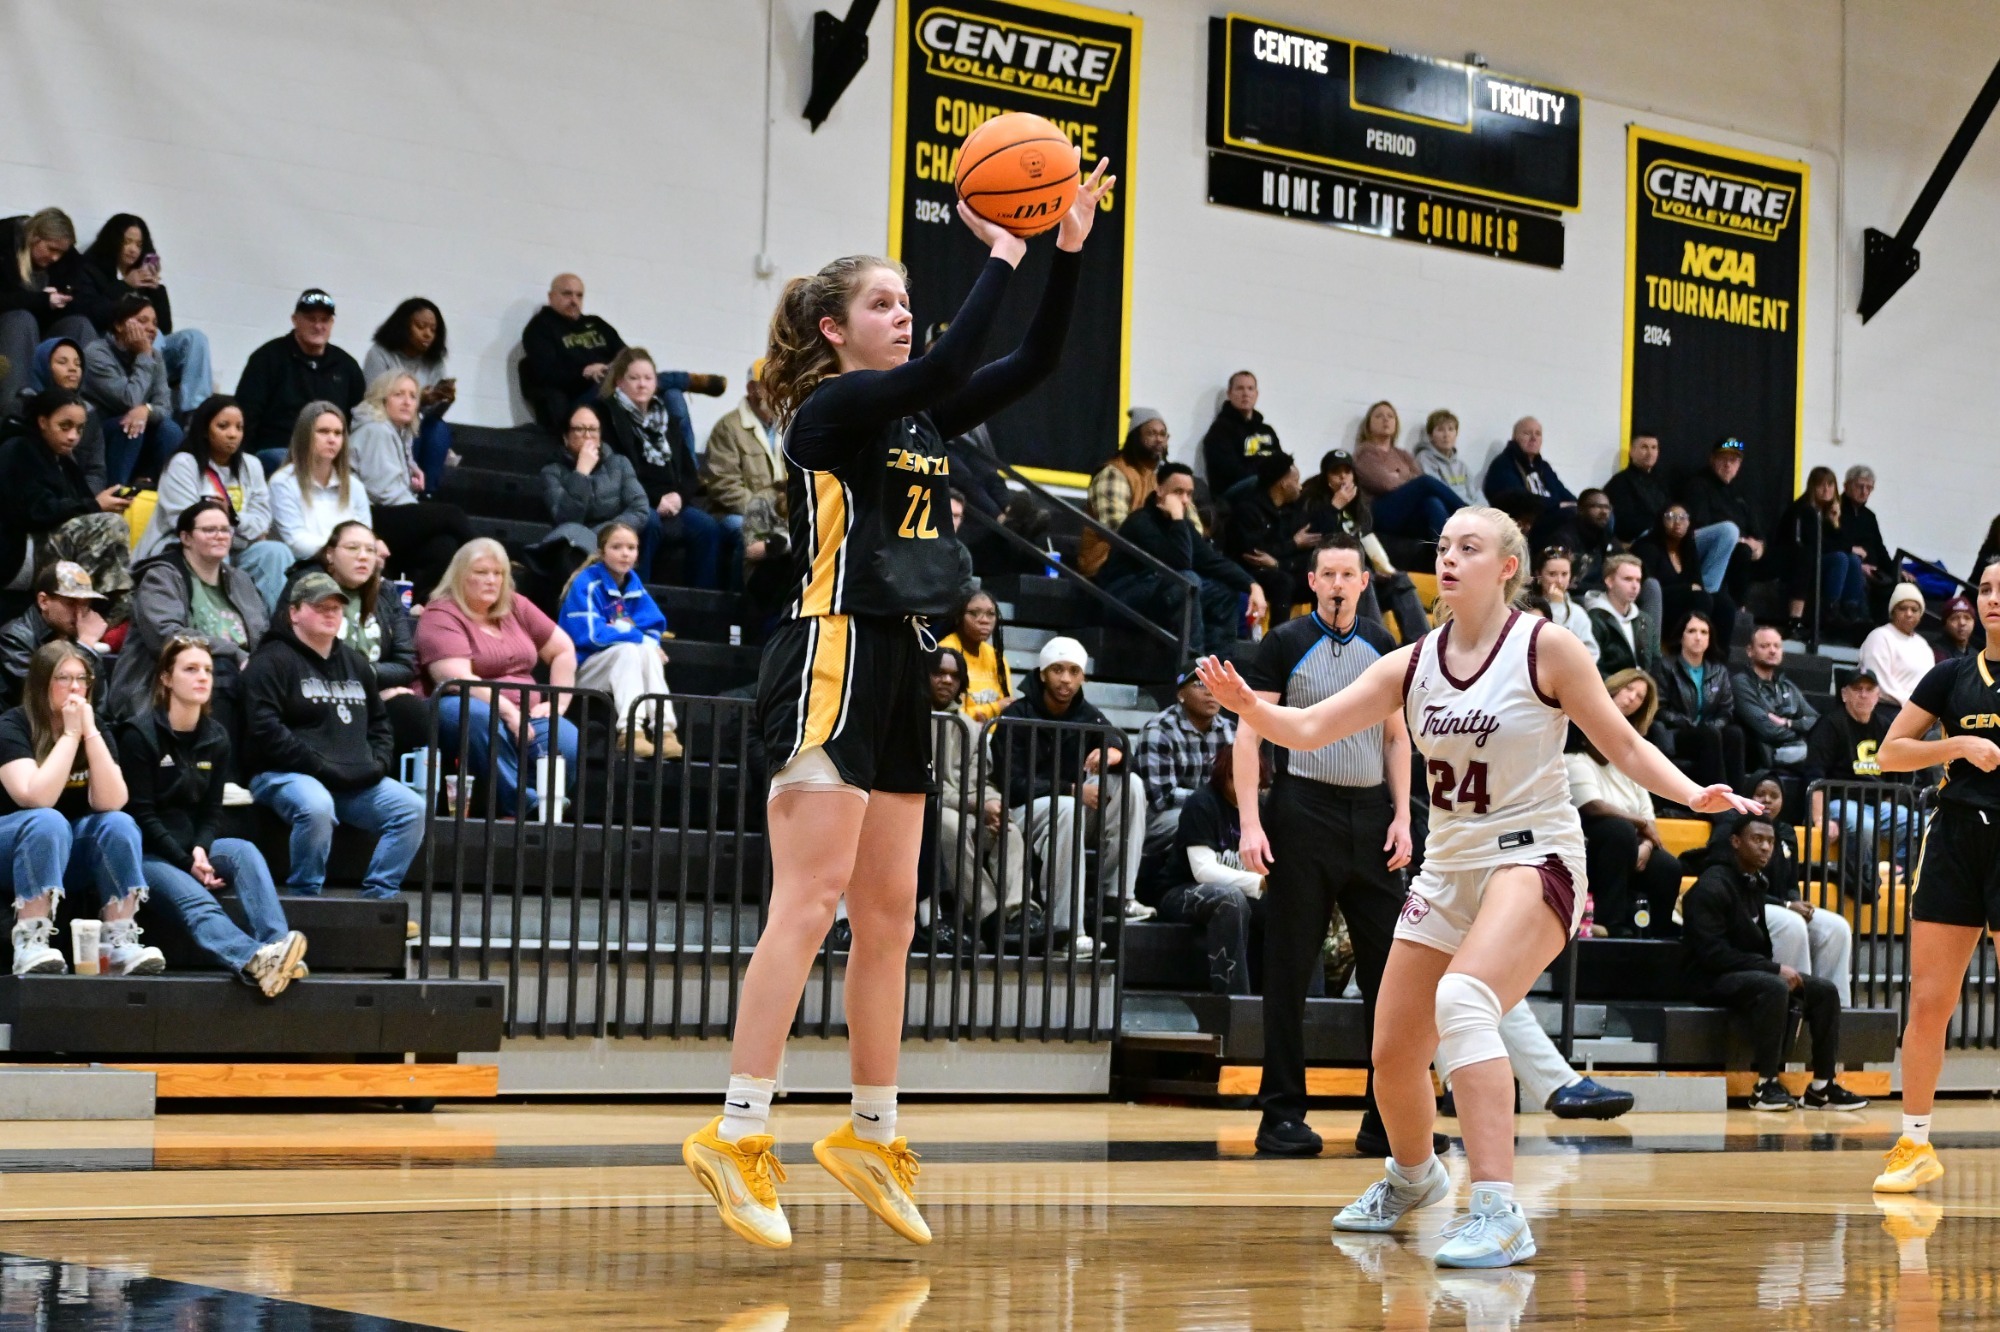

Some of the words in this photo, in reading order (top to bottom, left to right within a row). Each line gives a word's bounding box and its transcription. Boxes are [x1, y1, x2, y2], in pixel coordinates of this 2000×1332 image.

[923, 17, 1110, 80] CENTRE
[1254, 29, 1329, 74] CENTRE
[938, 53, 1092, 98] VOLLEYBALL
[1487, 81, 1565, 125] TRINITY
[1366, 128, 1417, 158] PERIOD
[915, 199, 951, 225] 2024
[1262, 170, 1320, 215] HOME
[1333, 184, 1357, 221] OF
[1370, 191, 1405, 231] THE
[1418, 202, 1519, 252] COLONELS
[1649, 168, 1787, 220] CENTRE
[1660, 199, 1774, 235] VOLLEYBALL
[1681, 240, 1756, 288] NCAA
[1645, 274, 1790, 333] TOURNAMENT
[1643, 325, 1671, 347] 2024
[898, 484, 940, 539] 22
[1420, 705, 1500, 748] Trinity
[1427, 758, 1491, 815] 24
